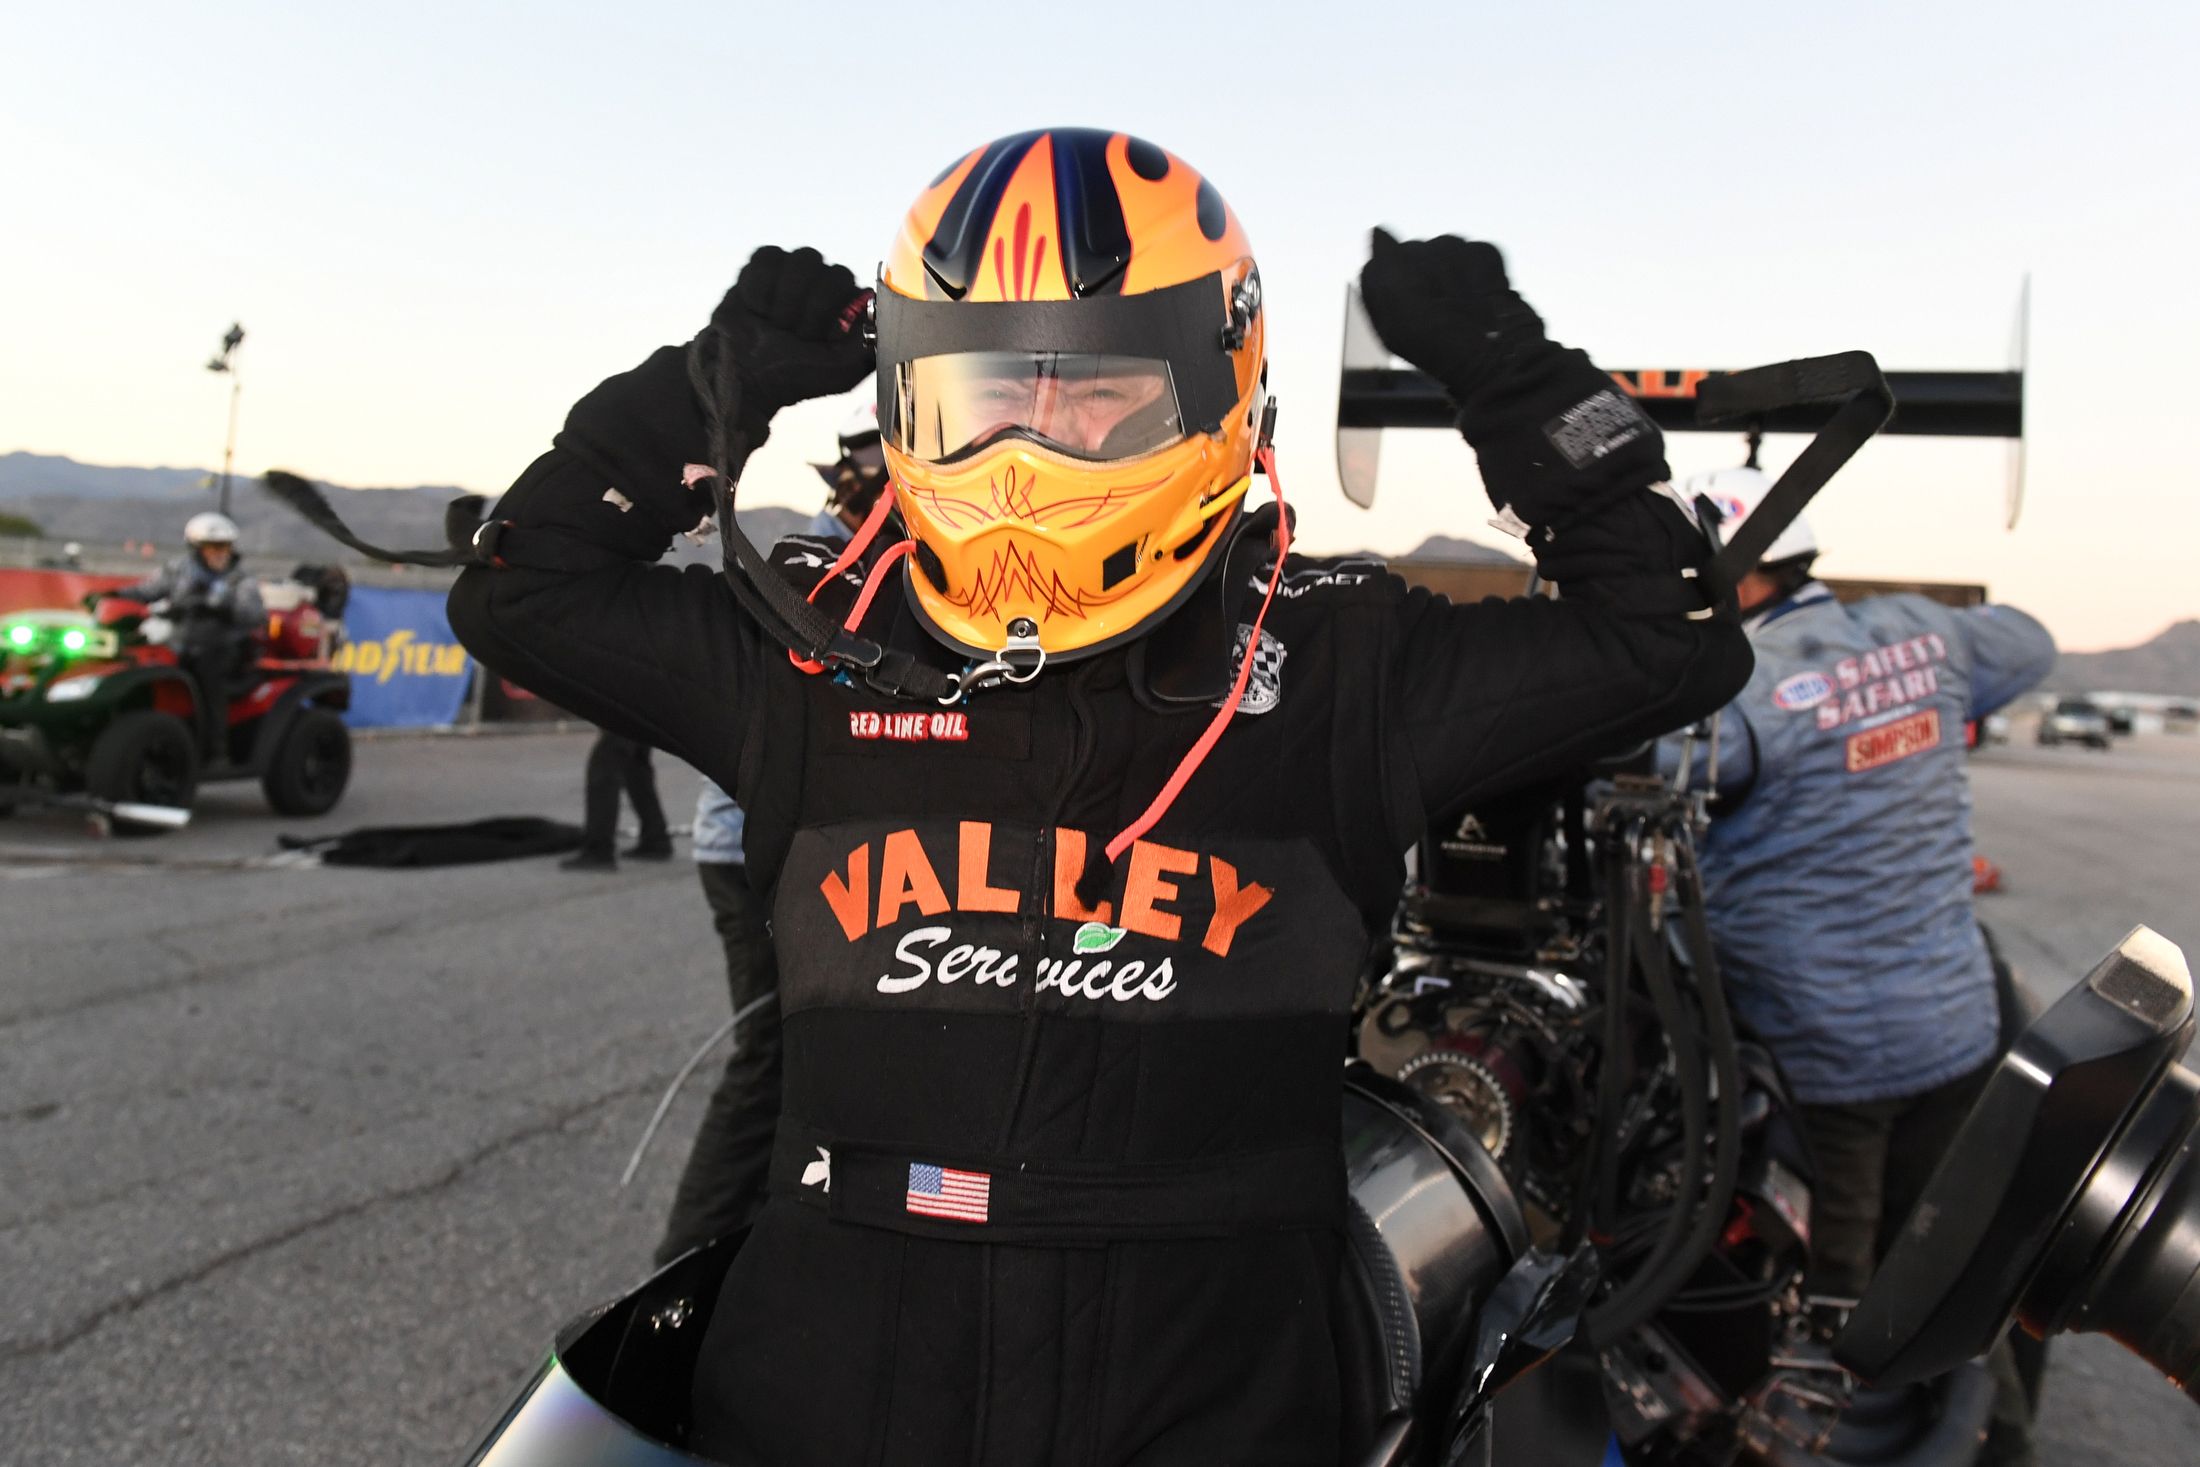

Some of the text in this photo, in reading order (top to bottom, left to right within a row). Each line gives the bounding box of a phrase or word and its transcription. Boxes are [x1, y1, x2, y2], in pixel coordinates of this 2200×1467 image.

[1276, 573, 1371, 598] IMACT
[1836, 634, 1946, 690] SAFETY
[850, 712, 966, 740] RED LINE OIL
[1817, 666, 1937, 731] SAFARI
[1855, 719, 1932, 760] SIMPSON
[820, 821, 1275, 958] VALLEY
[877, 926, 1178, 1001] Services
